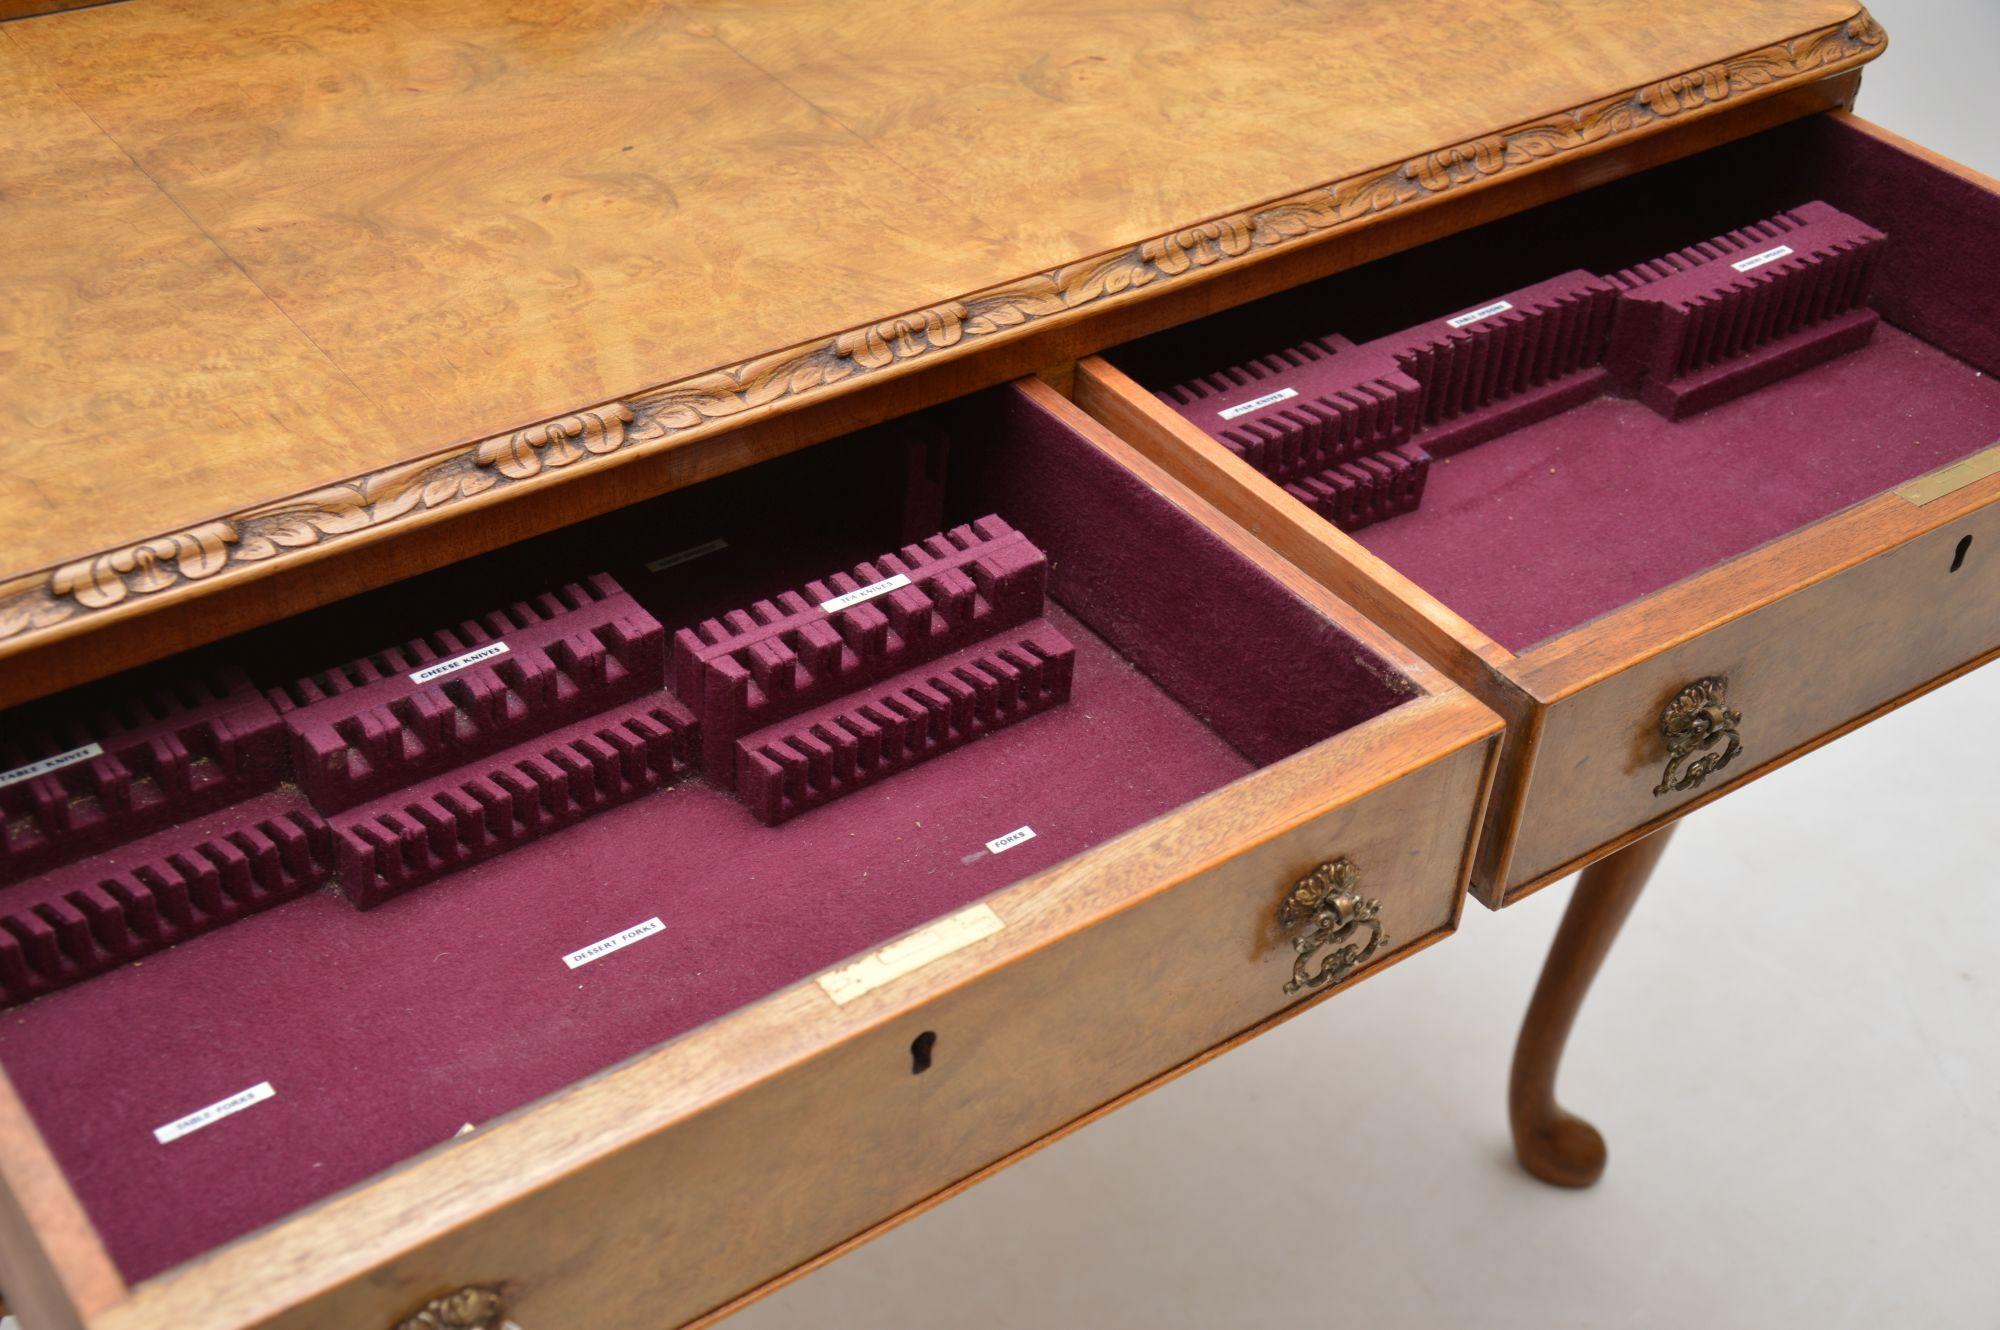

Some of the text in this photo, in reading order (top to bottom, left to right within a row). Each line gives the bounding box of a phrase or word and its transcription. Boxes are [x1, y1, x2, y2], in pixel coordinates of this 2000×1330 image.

[860, 581, 893, 598] KNIVES
[420, 646, 501, 680] CHEESE KNIVES
[45, 748, 90, 768] KNIVES
[994, 831, 1026, 848] FORKS
[573, 922, 657, 963] DESSERT FORKS
[216, 1092, 255, 1114] FORKS
